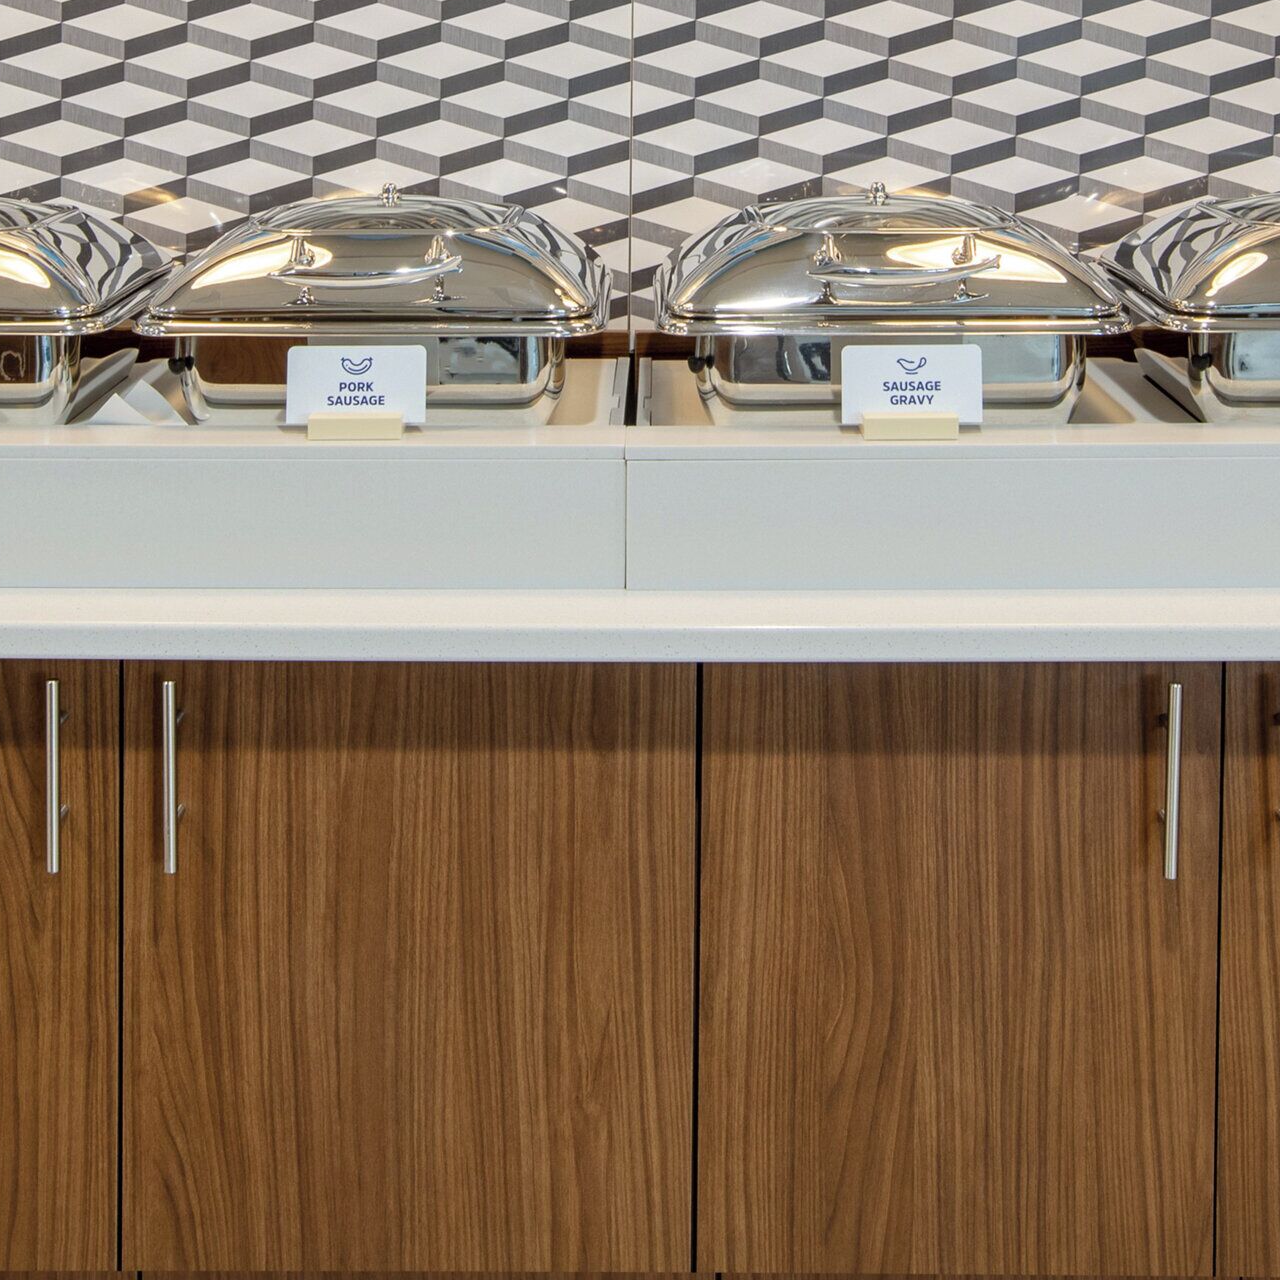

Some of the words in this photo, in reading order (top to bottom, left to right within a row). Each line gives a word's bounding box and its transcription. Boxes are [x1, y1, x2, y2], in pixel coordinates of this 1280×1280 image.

[339, 382, 374, 392] PORK
[883, 381, 941, 391] SAUSAGE
[327, 395, 385, 406] SAUSAGE
[890, 395, 934, 405] GRAVY
